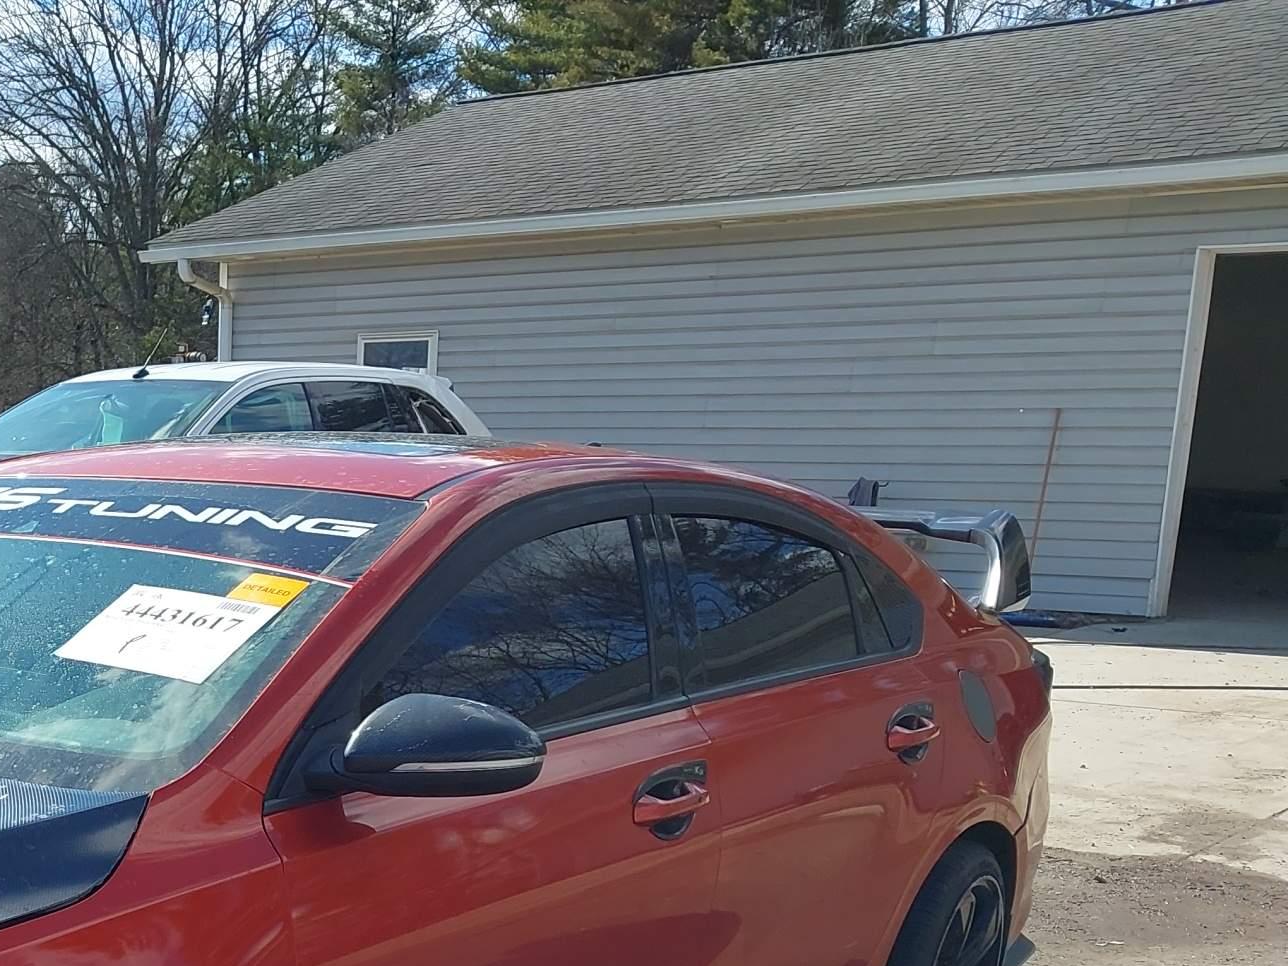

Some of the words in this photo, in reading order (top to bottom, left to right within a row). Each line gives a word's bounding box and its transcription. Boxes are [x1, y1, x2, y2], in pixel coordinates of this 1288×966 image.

[47, 498, 379, 539] TUNING
[242, 583, 292, 597] DETAILED
[121, 603, 244, 632] 44431617
